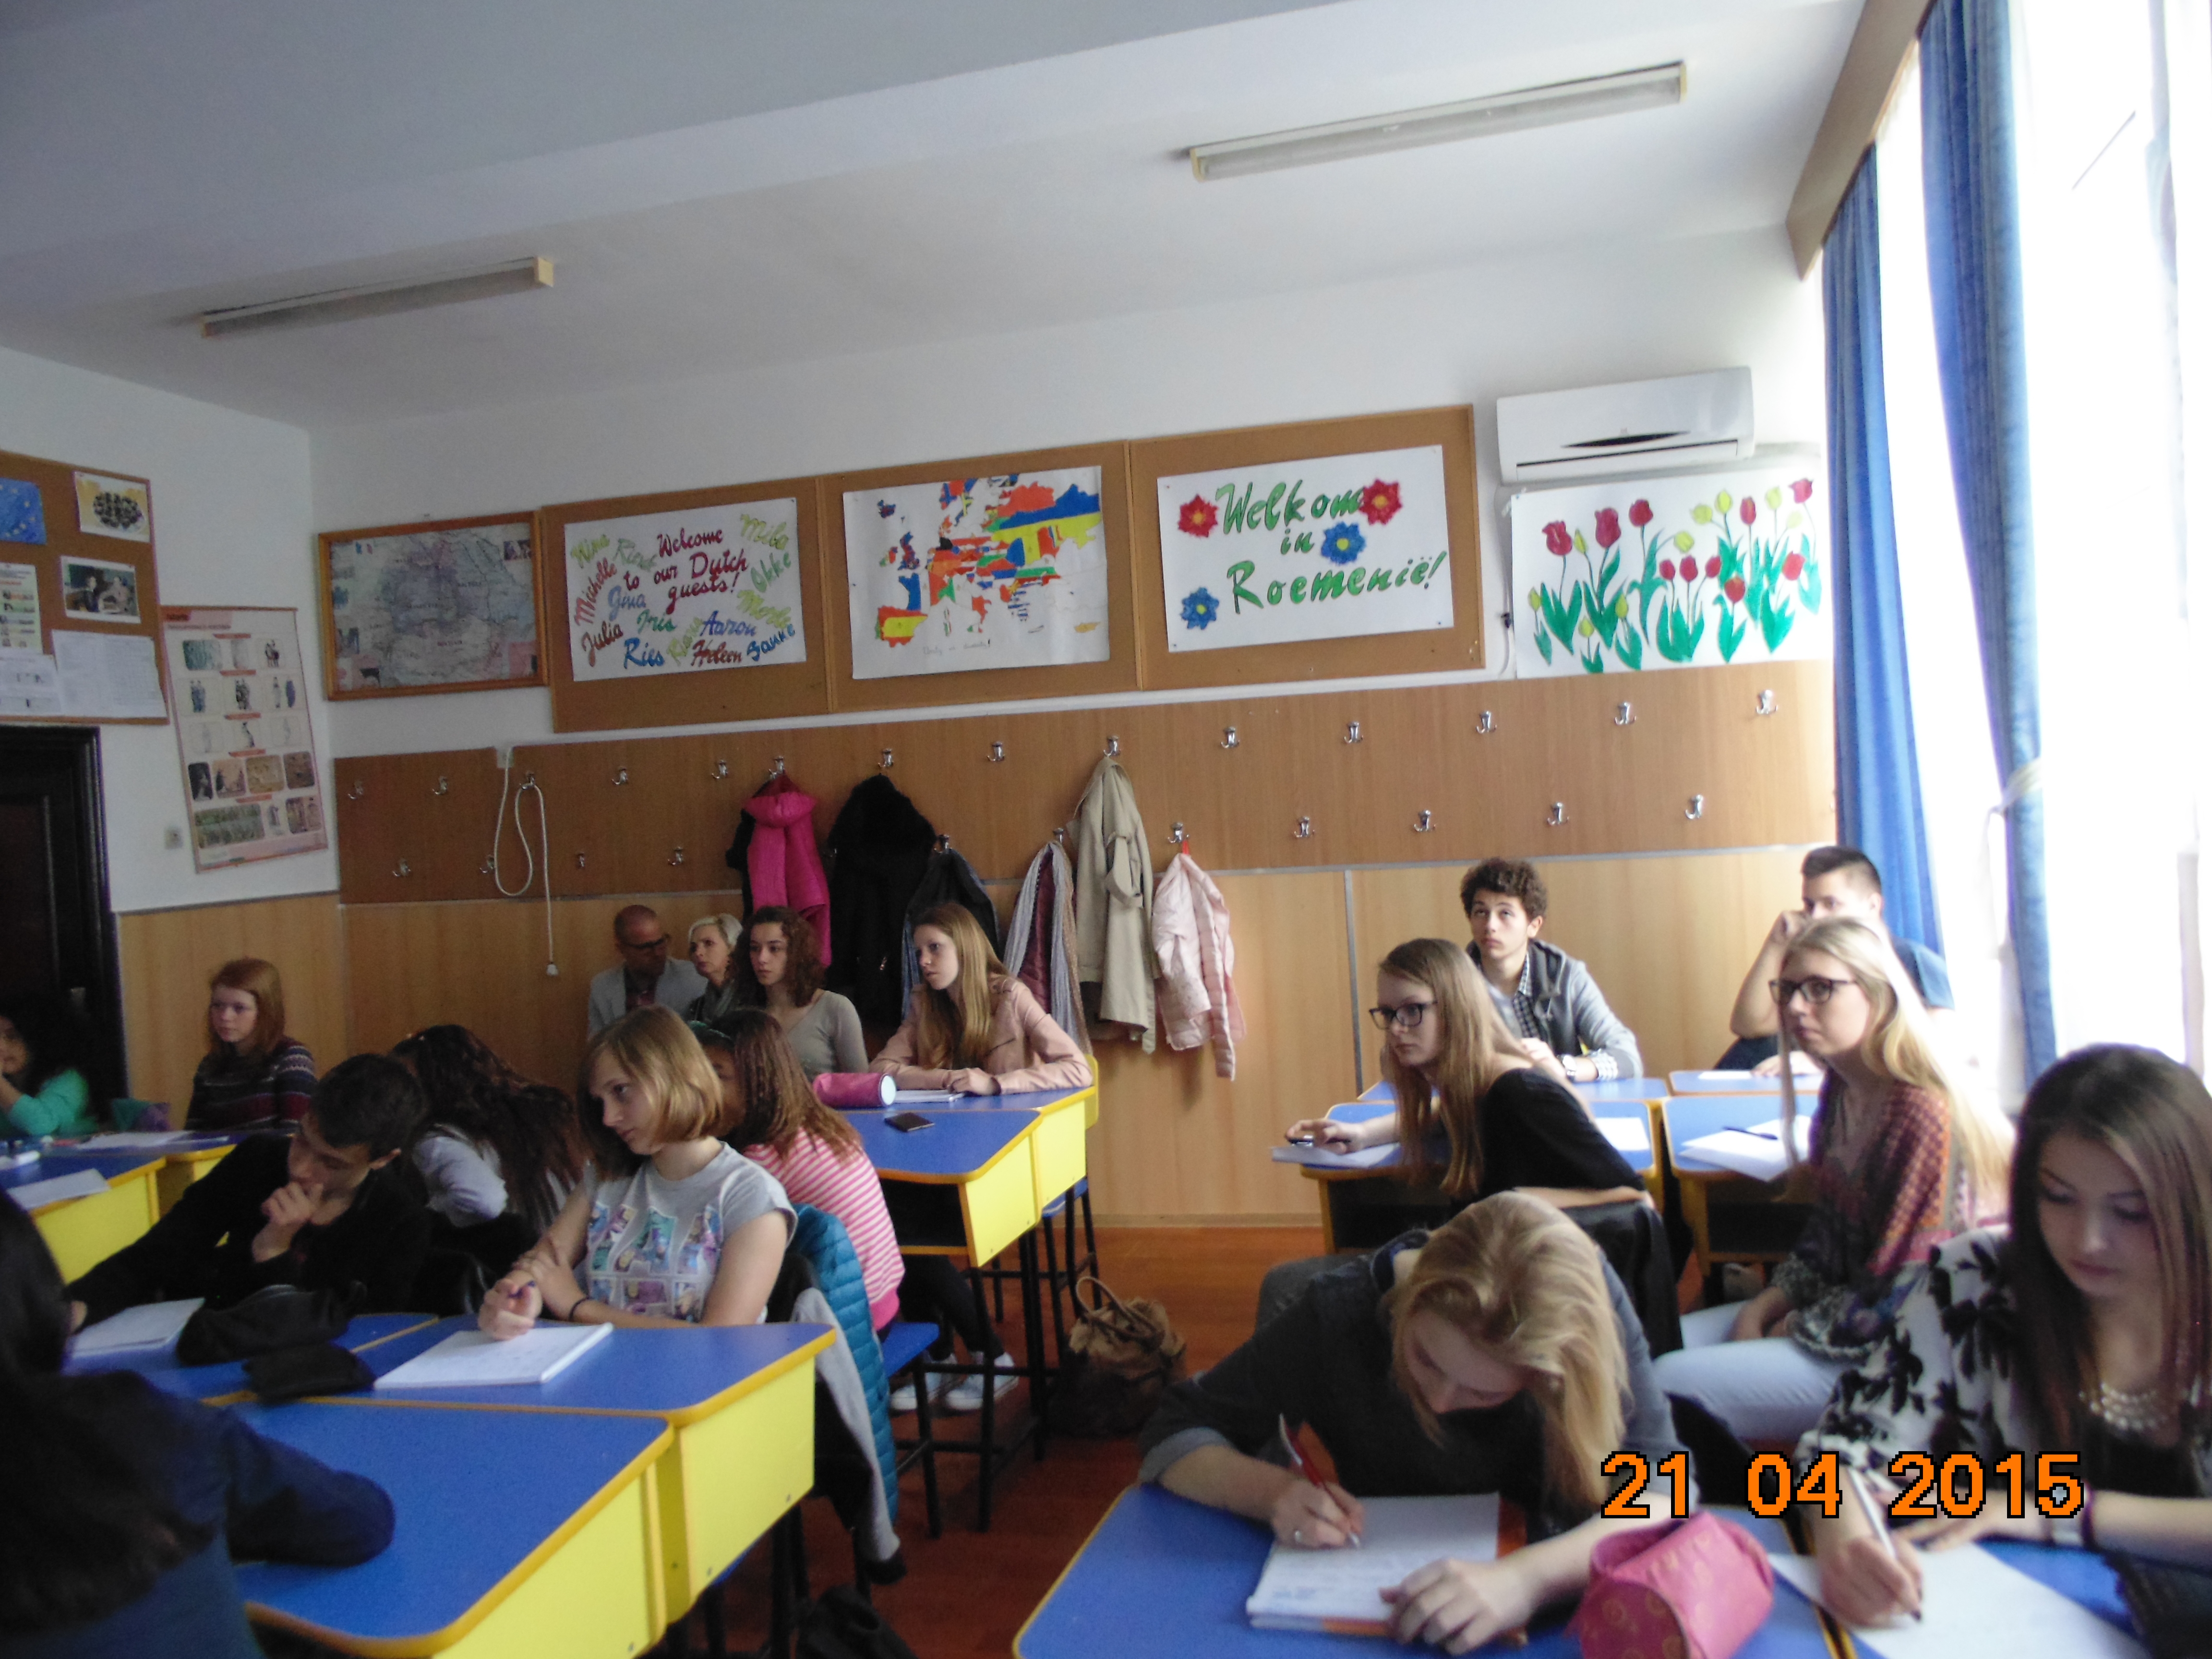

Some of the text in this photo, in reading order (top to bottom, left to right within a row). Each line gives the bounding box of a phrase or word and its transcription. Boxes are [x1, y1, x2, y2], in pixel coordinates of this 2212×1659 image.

[1215, 480, 1364, 534] Welkom
[657, 528, 723, 557] Welcome
[1280, 529, 1314, 555] in
[624, 548, 749, 591] to our Dutch
[1226, 551, 1447, 614] Roemenië!
[581, 621, 624, 667] Julia
[699, 610, 757, 637] Aaron
